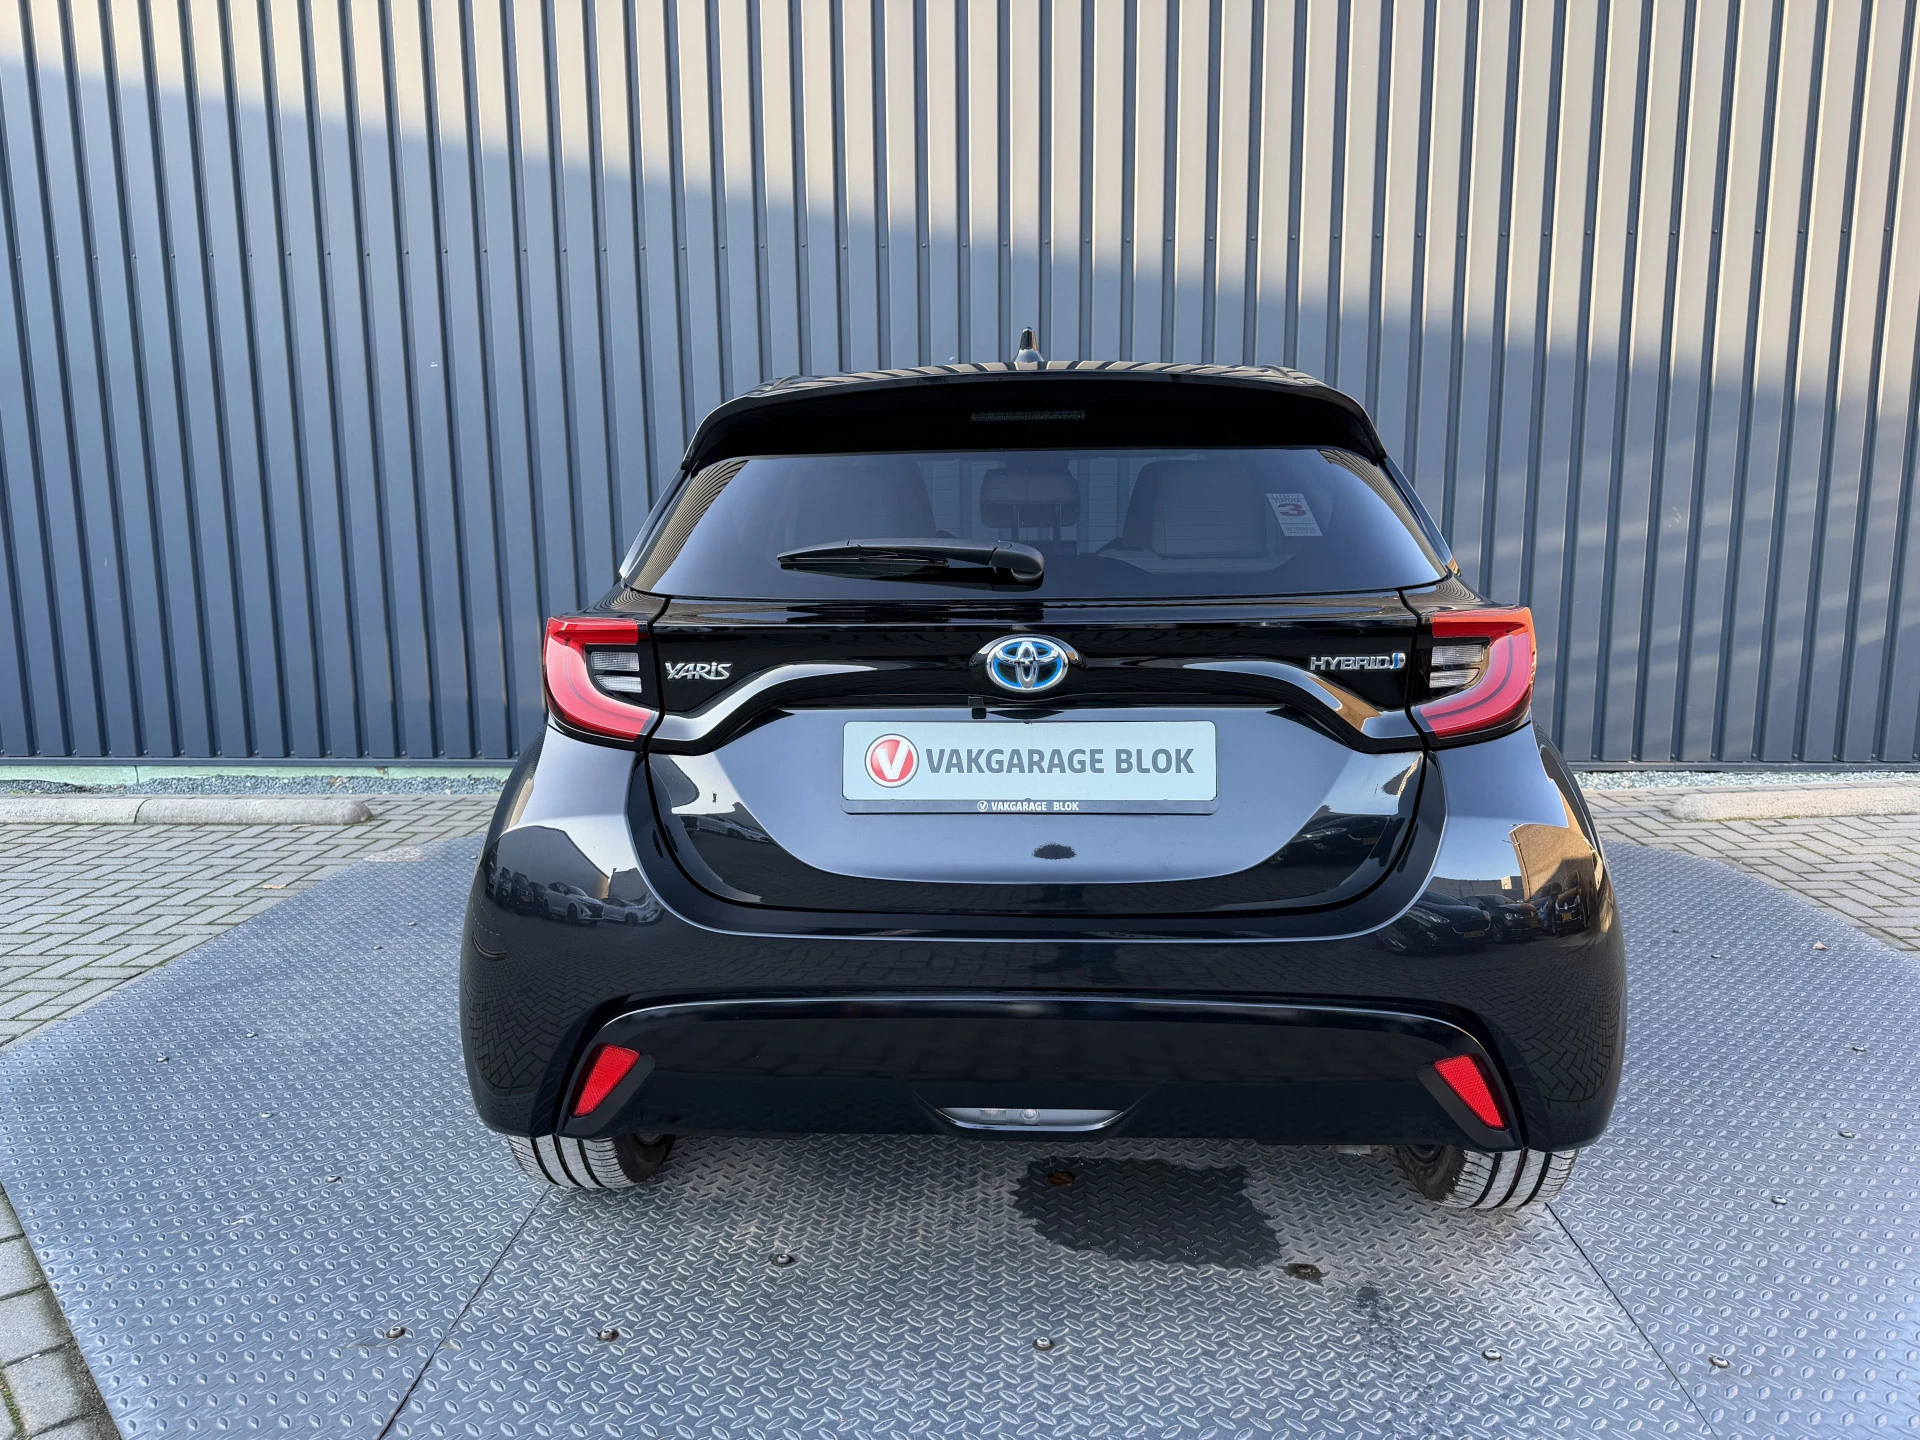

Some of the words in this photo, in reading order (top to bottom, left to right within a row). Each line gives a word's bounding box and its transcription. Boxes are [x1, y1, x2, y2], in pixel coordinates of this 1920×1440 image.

[1277, 503, 1307, 517] 3
[1309, 656, 1391, 671] HYBRID
[926, 748, 1105, 774] VAKGARAGE
[1115, 748, 1195, 774] BLOK
[991, 801, 1047, 811] VAKGARAGE
[1053, 801, 1079, 811] BLOK
